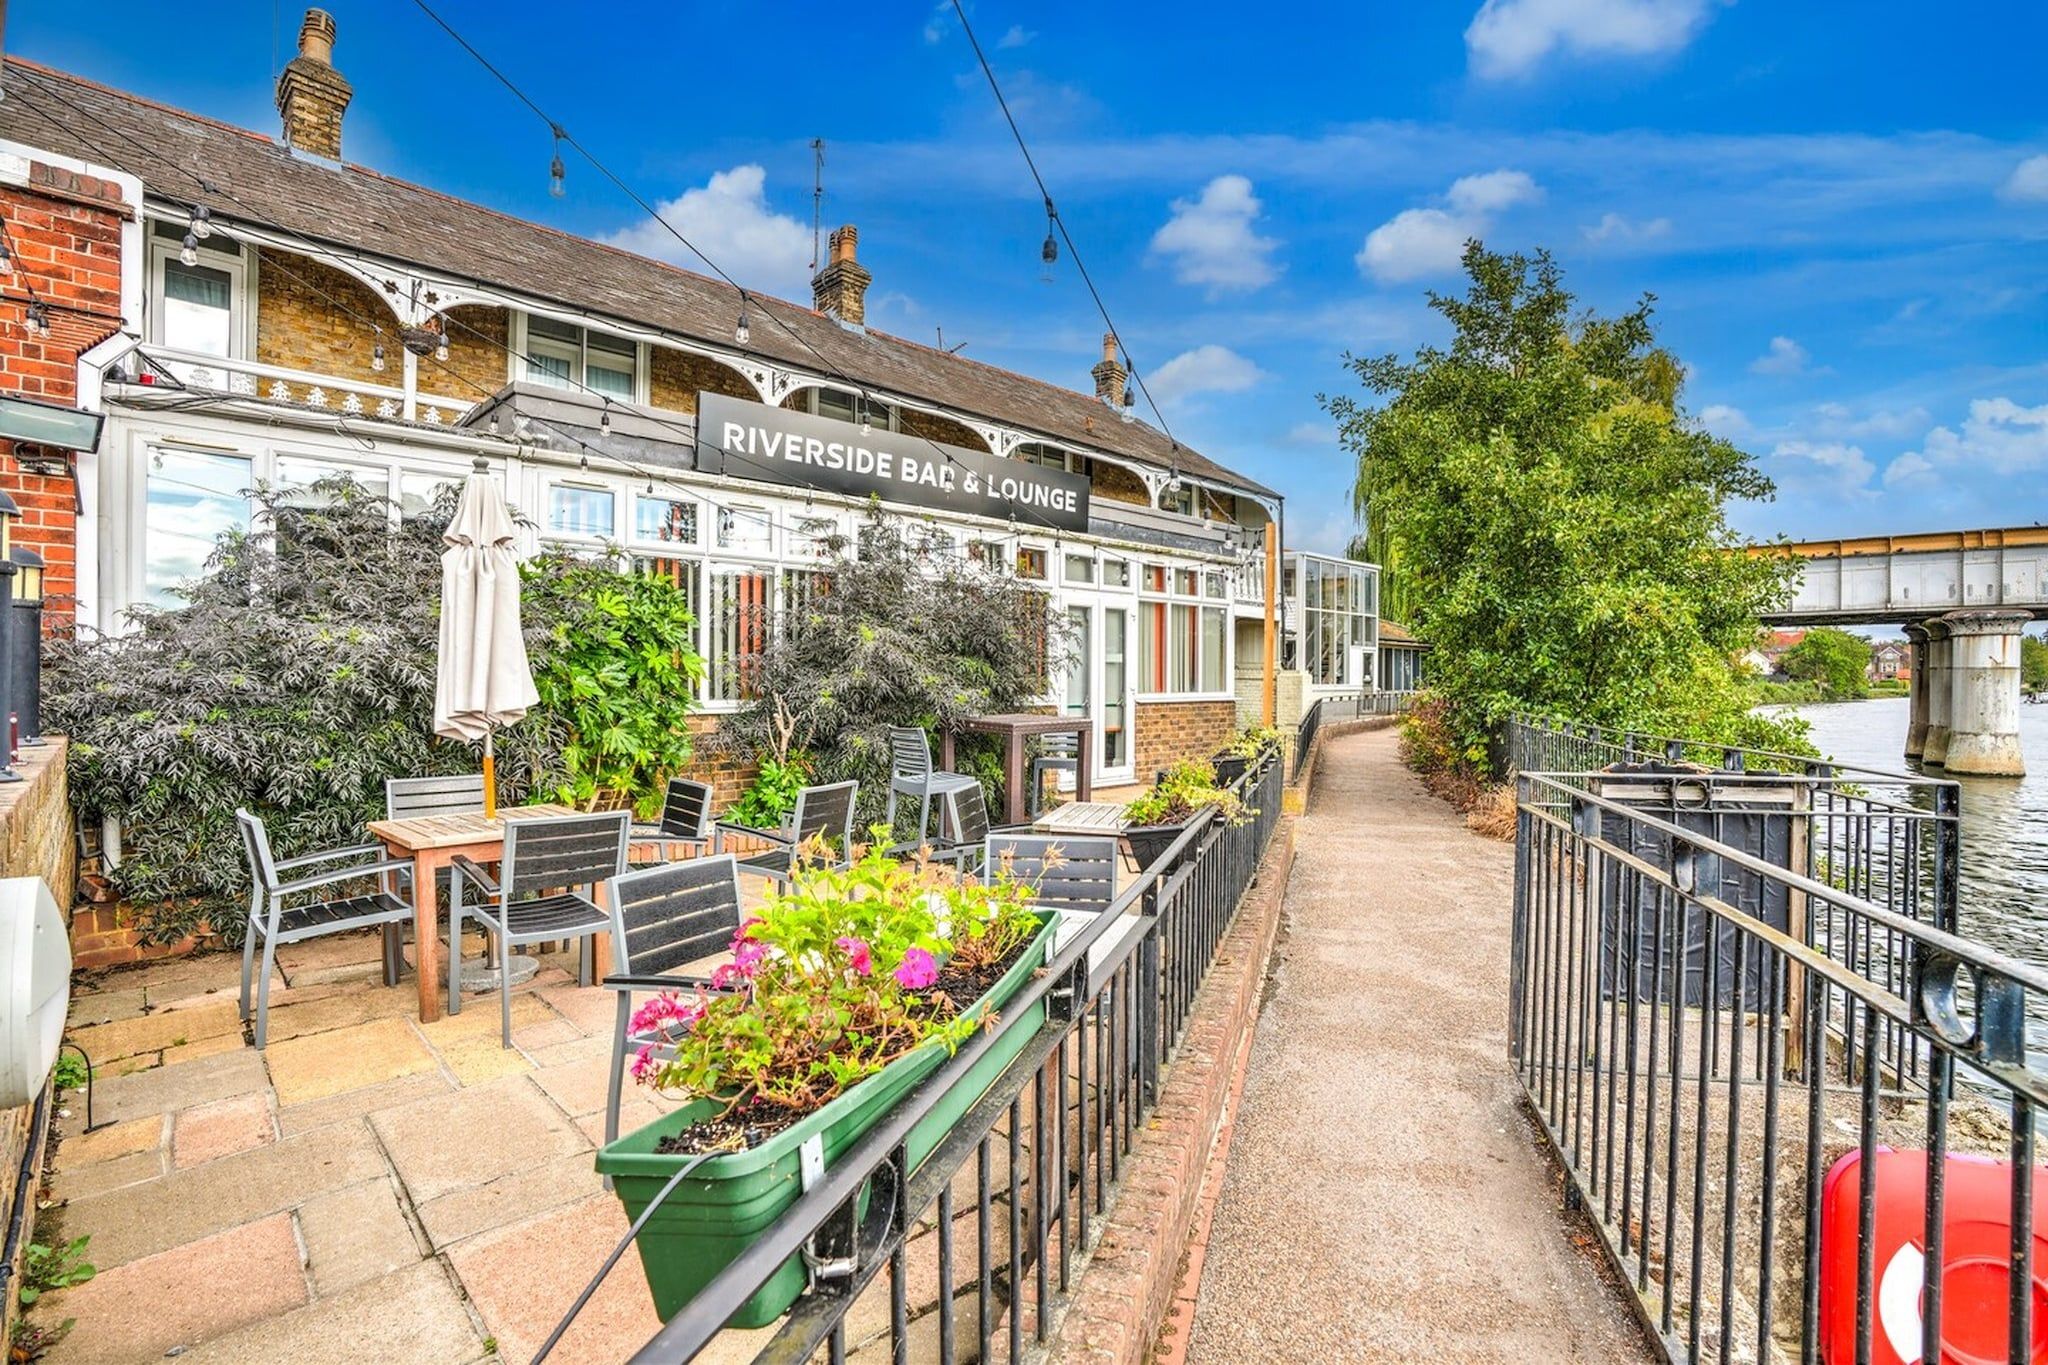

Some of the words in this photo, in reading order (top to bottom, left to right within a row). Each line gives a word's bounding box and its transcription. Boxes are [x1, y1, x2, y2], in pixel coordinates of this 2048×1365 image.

[722, 421, 893, 479] RIVERSIDE
[900, 457, 956, 490] BAR
[963, 471, 981, 493] &
[987, 474, 1078, 513] LOUNGE
